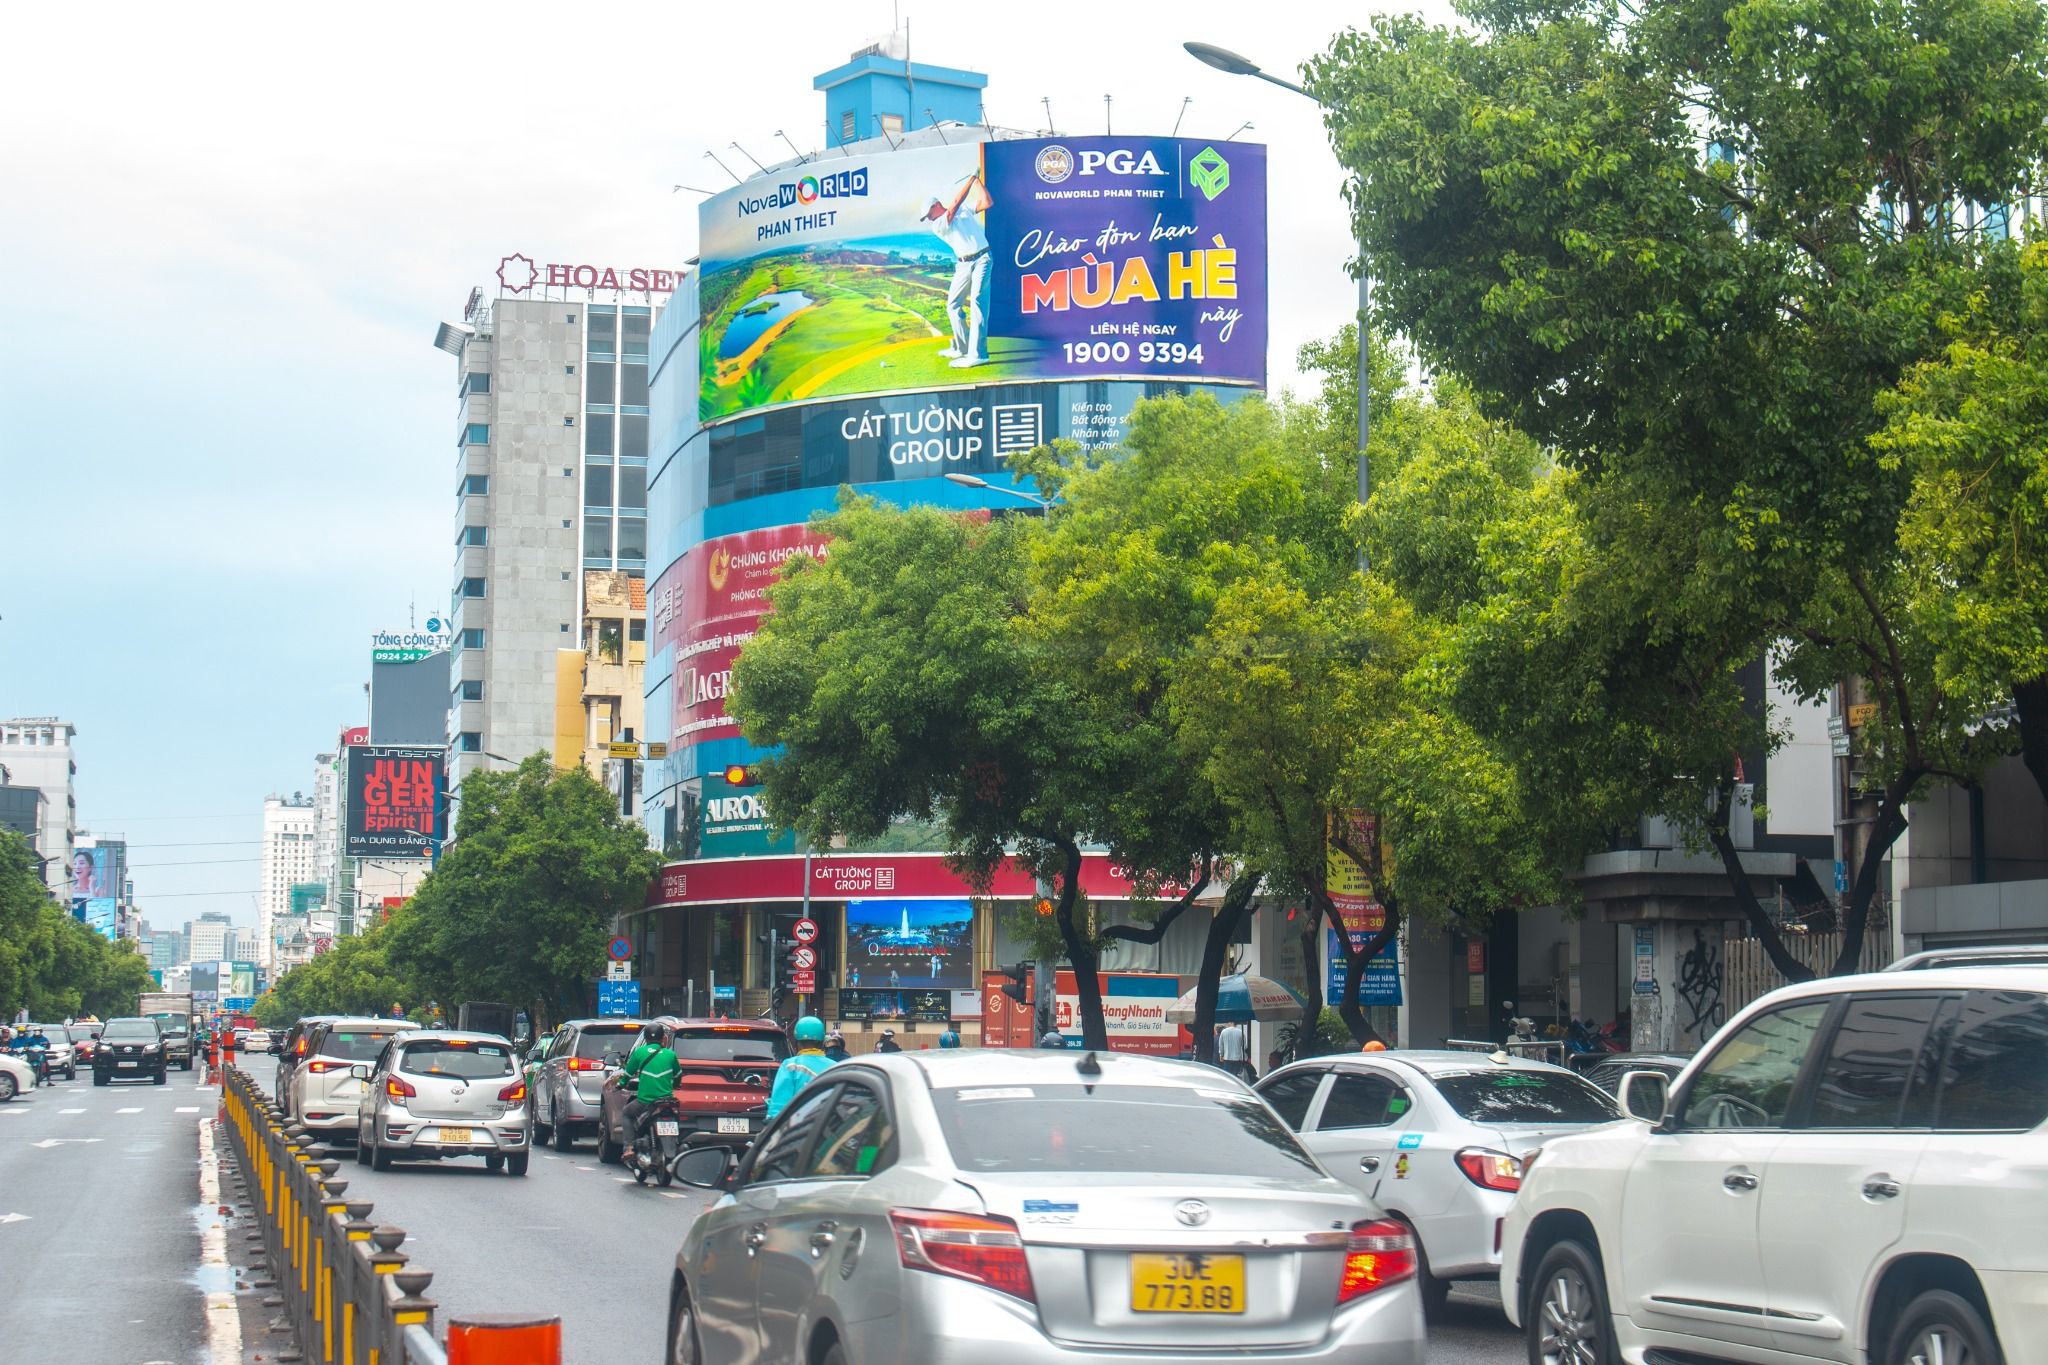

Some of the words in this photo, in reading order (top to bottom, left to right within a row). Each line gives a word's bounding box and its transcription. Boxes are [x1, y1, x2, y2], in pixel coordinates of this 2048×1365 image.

[1079, 149, 1165, 175] PGA
[1035, 190, 1100, 200] NOVAWORLD
[1103, 189, 1133, 198] PHAN
[1136, 189, 1165, 198] THIET
[757, 219, 791, 241] PHAN
[794, 211, 837, 231] THIET
[1015, 229, 1088, 268] Chào
[1148, 213, 1198, 242] bạn
[547, 264, 623, 290] HOA
[1021, 252, 1160, 314] MÙA
[1168, 233, 1237, 300] HÈ
[1090, 323, 1119, 335] LIÊN
[1122, 323, 1139, 337] HỆ
[1142, 325, 1176, 336] NGAY
[1200, 306, 1243, 343] này
[1063, 341, 1130, 363] 1900
[1138, 343, 1204, 364] 9394
[1071, 401, 1093, 412] Kiến
[1095, 403, 1112, 413] tạo
[841, 409, 885, 440] CÁT
[890, 405, 983, 436] TƯỜNG
[1071, 414, 1089, 425] Bất
[1091, 414, 1117, 427] động
[1071, 427, 1098, 438] Nhân
[1101, 427, 1119, 438] văn
[890, 437, 982, 465] GROUP
[372, 630, 401, 646] TỔNG
[404, 633, 434, 646] CÔNG
[436, 635, 451, 646] TY
[376, 653, 400, 661] 0924
[402, 653, 415, 661] 24
[365, 759, 433, 785] JUN
[364, 782, 435, 807] GER
[350, 836, 367, 844] GIA
[369, 837, 396, 846] DỤNG
[815, 867, 834, 879] CÁT
[835, 865, 872, 878] TƯỜNG
[835, 879, 872, 890] GROUP
[1369, 918, 1385, 927] 30/
[722, 1125, 746, 1133] 493.74
[1145, 1284, 1233, 1309] 773.88
